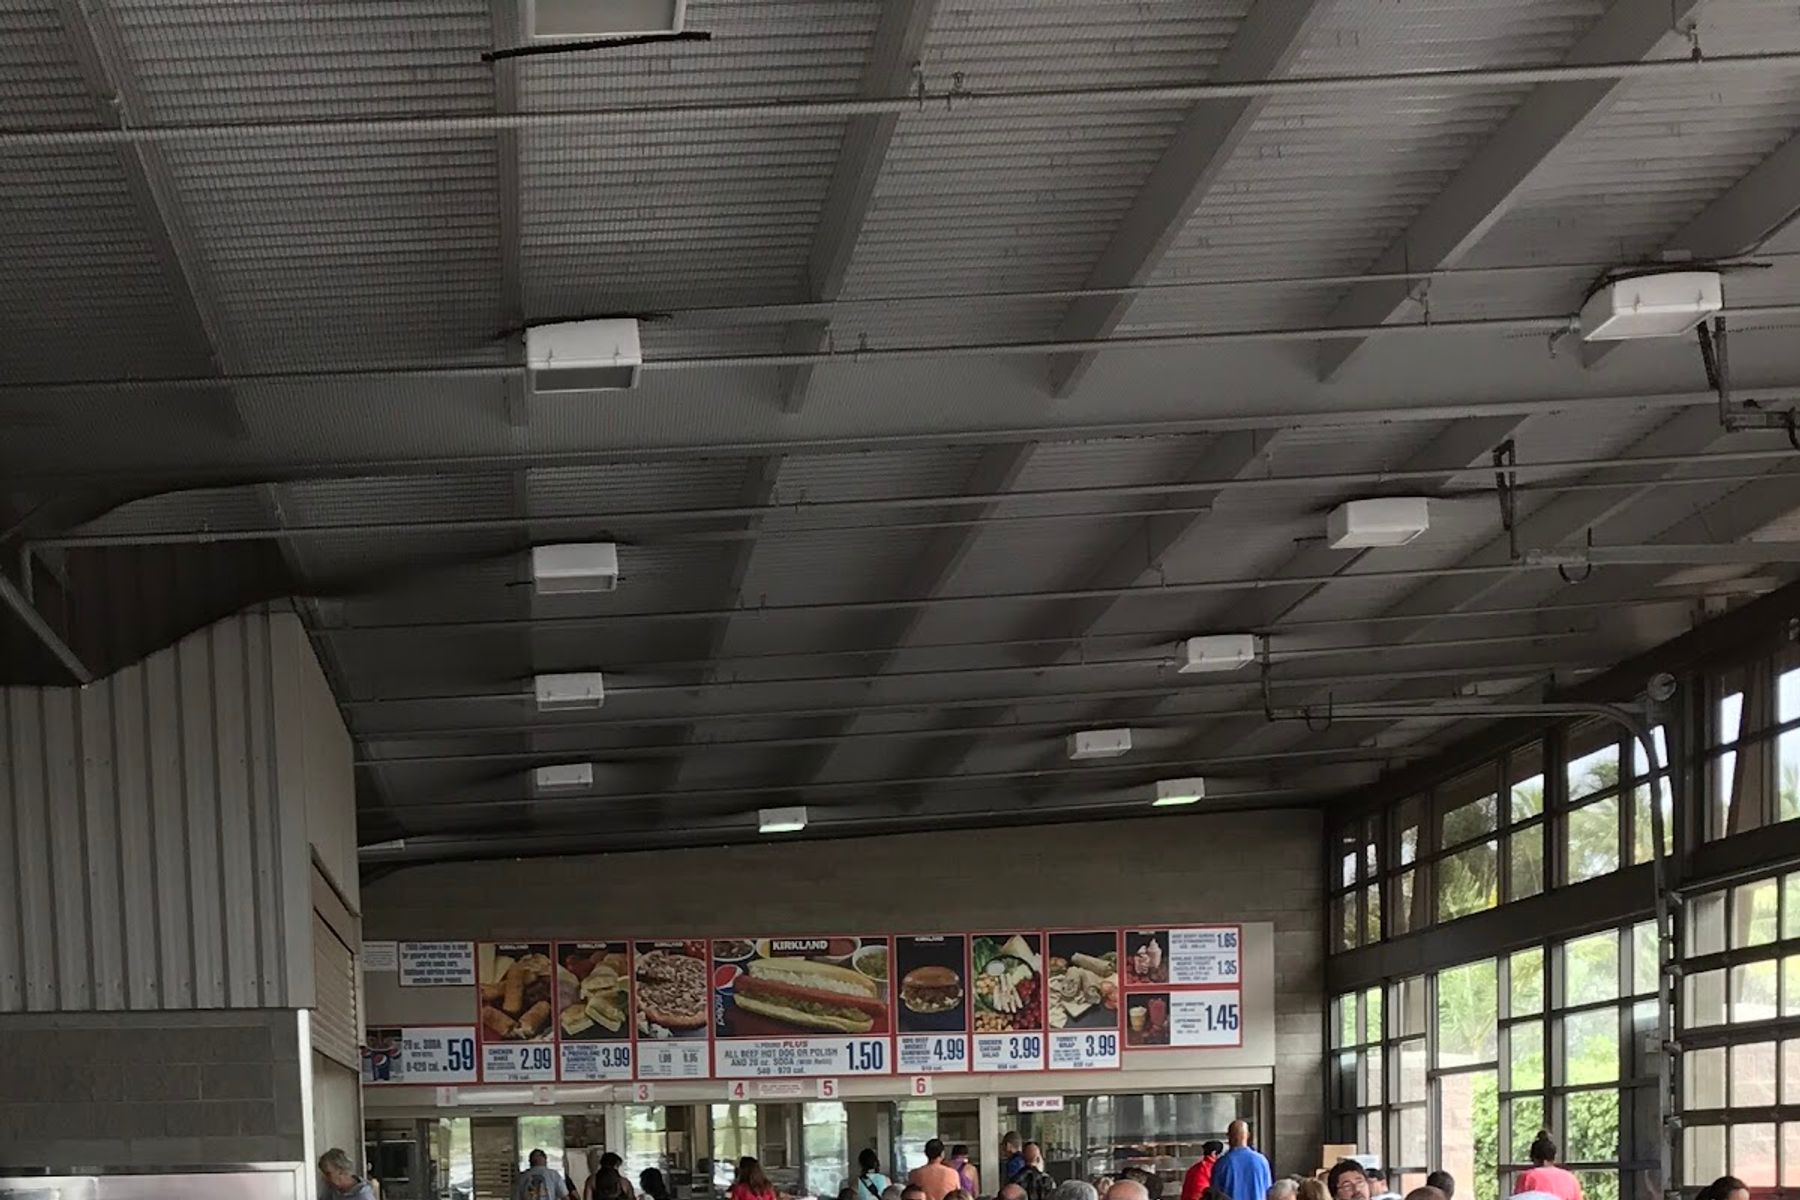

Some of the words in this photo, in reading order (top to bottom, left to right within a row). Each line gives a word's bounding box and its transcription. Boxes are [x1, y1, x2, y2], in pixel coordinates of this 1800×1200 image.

[772, 940, 829, 951] KIRKLAND
[1205, 1003, 1239, 1031] 1.45
[724, 1050, 738, 1058] ALL
[740, 1049, 758, 1058] BEEF
[761, 1049, 776, 1057] HOT
[778, 1049, 795, 1057] DOG
[797, 1048, 808, 1057] OR
[809, 1047, 839, 1056] POLISH
[782, 1040, 808, 1048] PLUS
[933, 1037, 965, 1060] 4.99
[1009, 1036, 1040, 1060] 3.99
[1086, 1034, 1116, 1057] 3.99
[442, 1037, 474, 1071] .59
[520, 1047, 551, 1071] 2.99
[601, 1047, 630, 1068] 3.99
[730, 1058, 747, 1067] AND
[773, 1057, 795, 1066] SODA
[845, 1040, 883, 1071] 1.50
[638, 1084, 648, 1100] 3
[734, 1082, 744, 1099] 4
[823, 1080, 833, 1096] 5
[916, 1077, 926, 1094] 6
